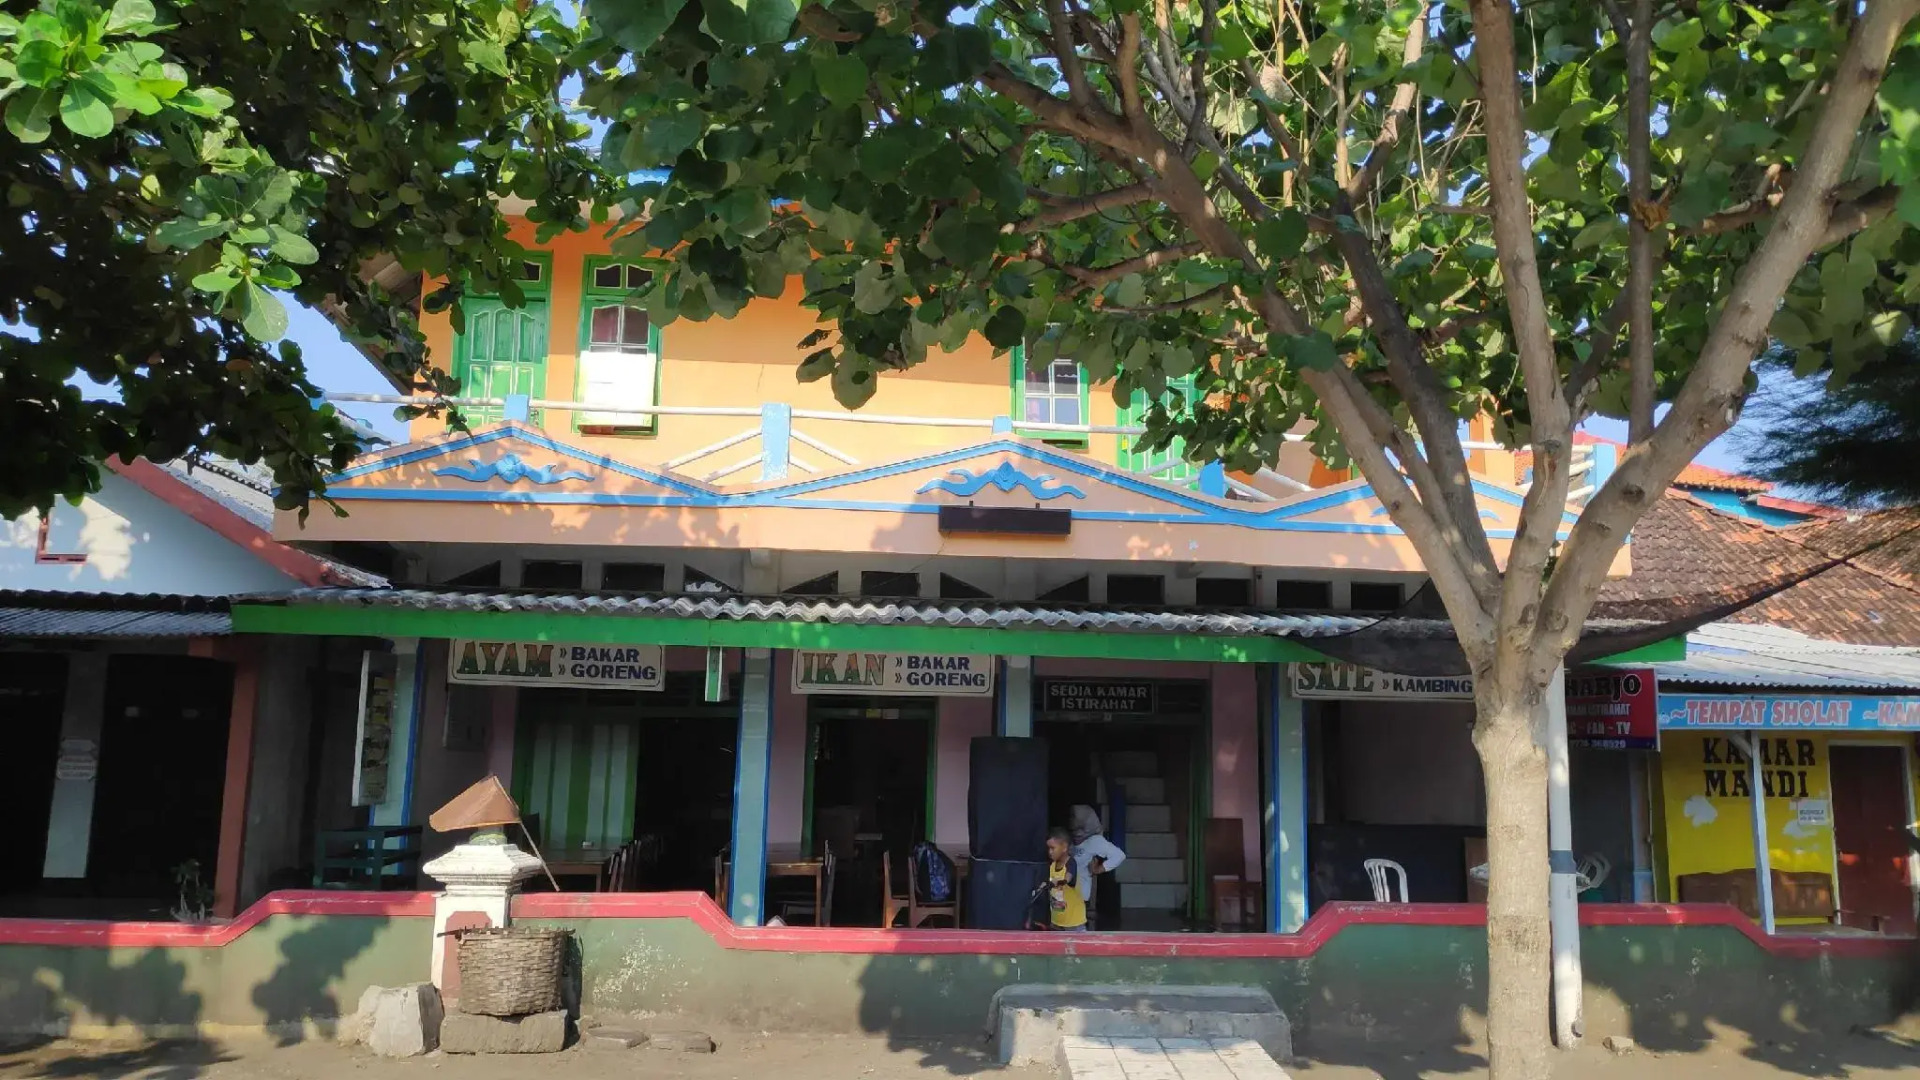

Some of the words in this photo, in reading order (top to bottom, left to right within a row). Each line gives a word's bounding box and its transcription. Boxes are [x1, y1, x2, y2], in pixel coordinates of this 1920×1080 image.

[457, 641, 553, 677] AYAM
[571, 646, 639, 663] BAKAR
[907, 656, 970, 670] BAKAR
[571, 663, 656, 680] GORENG
[801, 653, 886, 686] IKAN
[1298, 662, 1374, 692] SATE
[1393, 679, 1472, 693] KAMBING
[906, 672, 985, 687] GORENG
[1050, 685, 1092, 697] SEDIA
[1097, 686, 1147, 698] KAMAR
[1061, 697, 1136, 710] ISTIRAHAT
[1770, 700, 1852, 726] SHOLAT
[1616, 721, 1631, 735] TV
